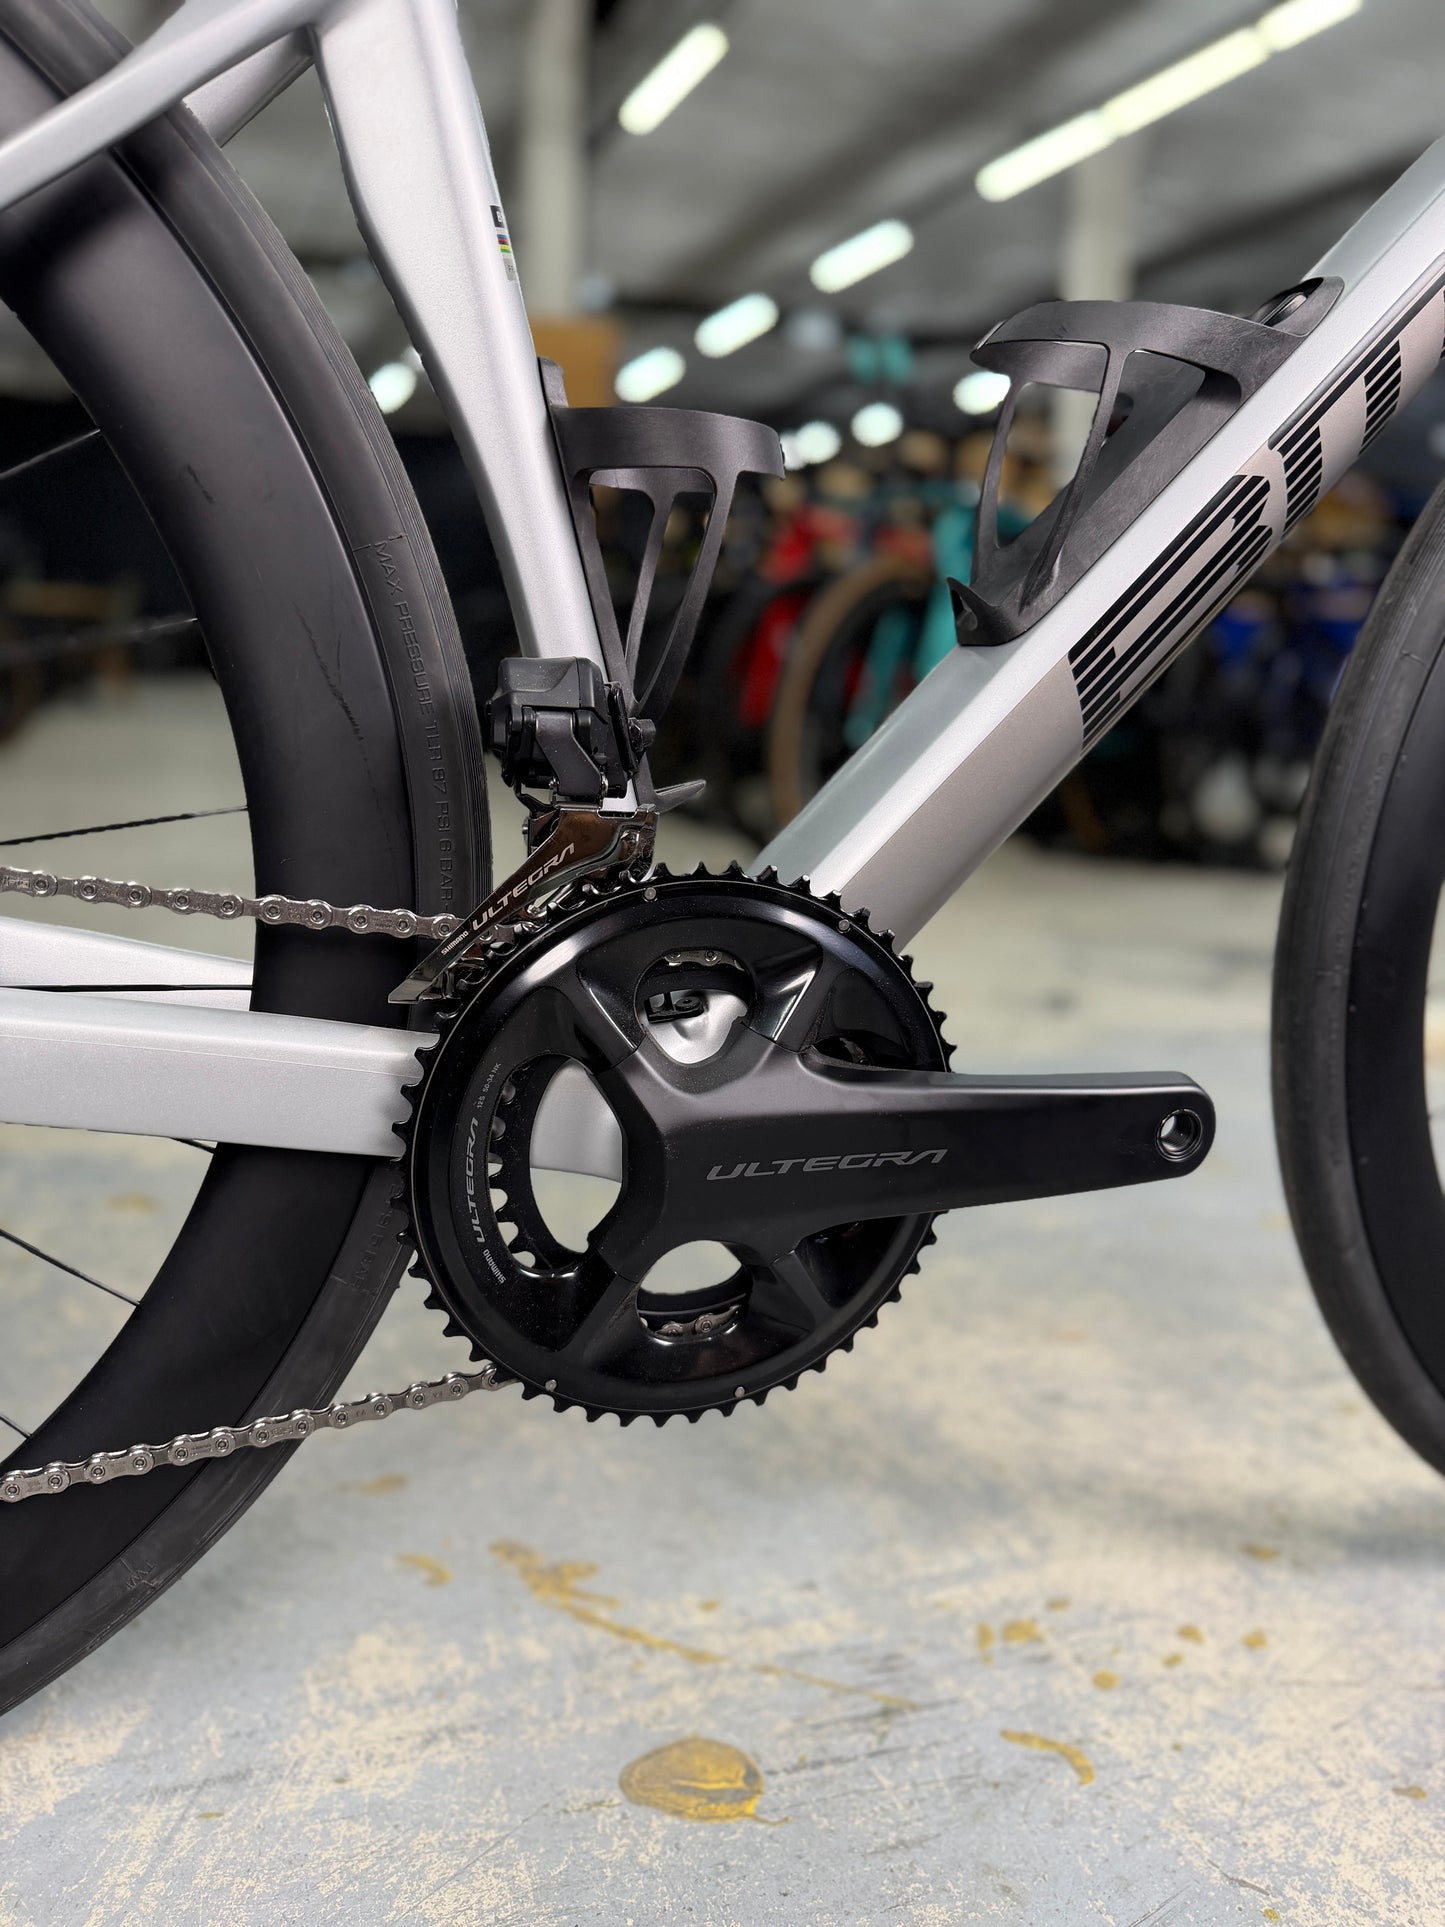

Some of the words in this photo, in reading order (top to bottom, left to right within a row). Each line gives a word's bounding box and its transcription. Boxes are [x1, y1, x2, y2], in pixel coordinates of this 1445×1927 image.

[374, 541, 403, 596] MAX
[393, 600, 435, 715] PRESSURE
[423, 719, 443, 761] TLR
[431, 767, 447, 795] 87
[435, 802, 451, 833] PSI
[439, 839, 452, 853] 6
[472, 842, 575, 931] ULTEGRA
[441, 930, 469, 956] SHIMANO
[465, 1116, 486, 1243] ULTEGRA
[706, 1148, 949, 1181] ULTEGRA
[482, 1248, 507, 1285] SHIMANO
